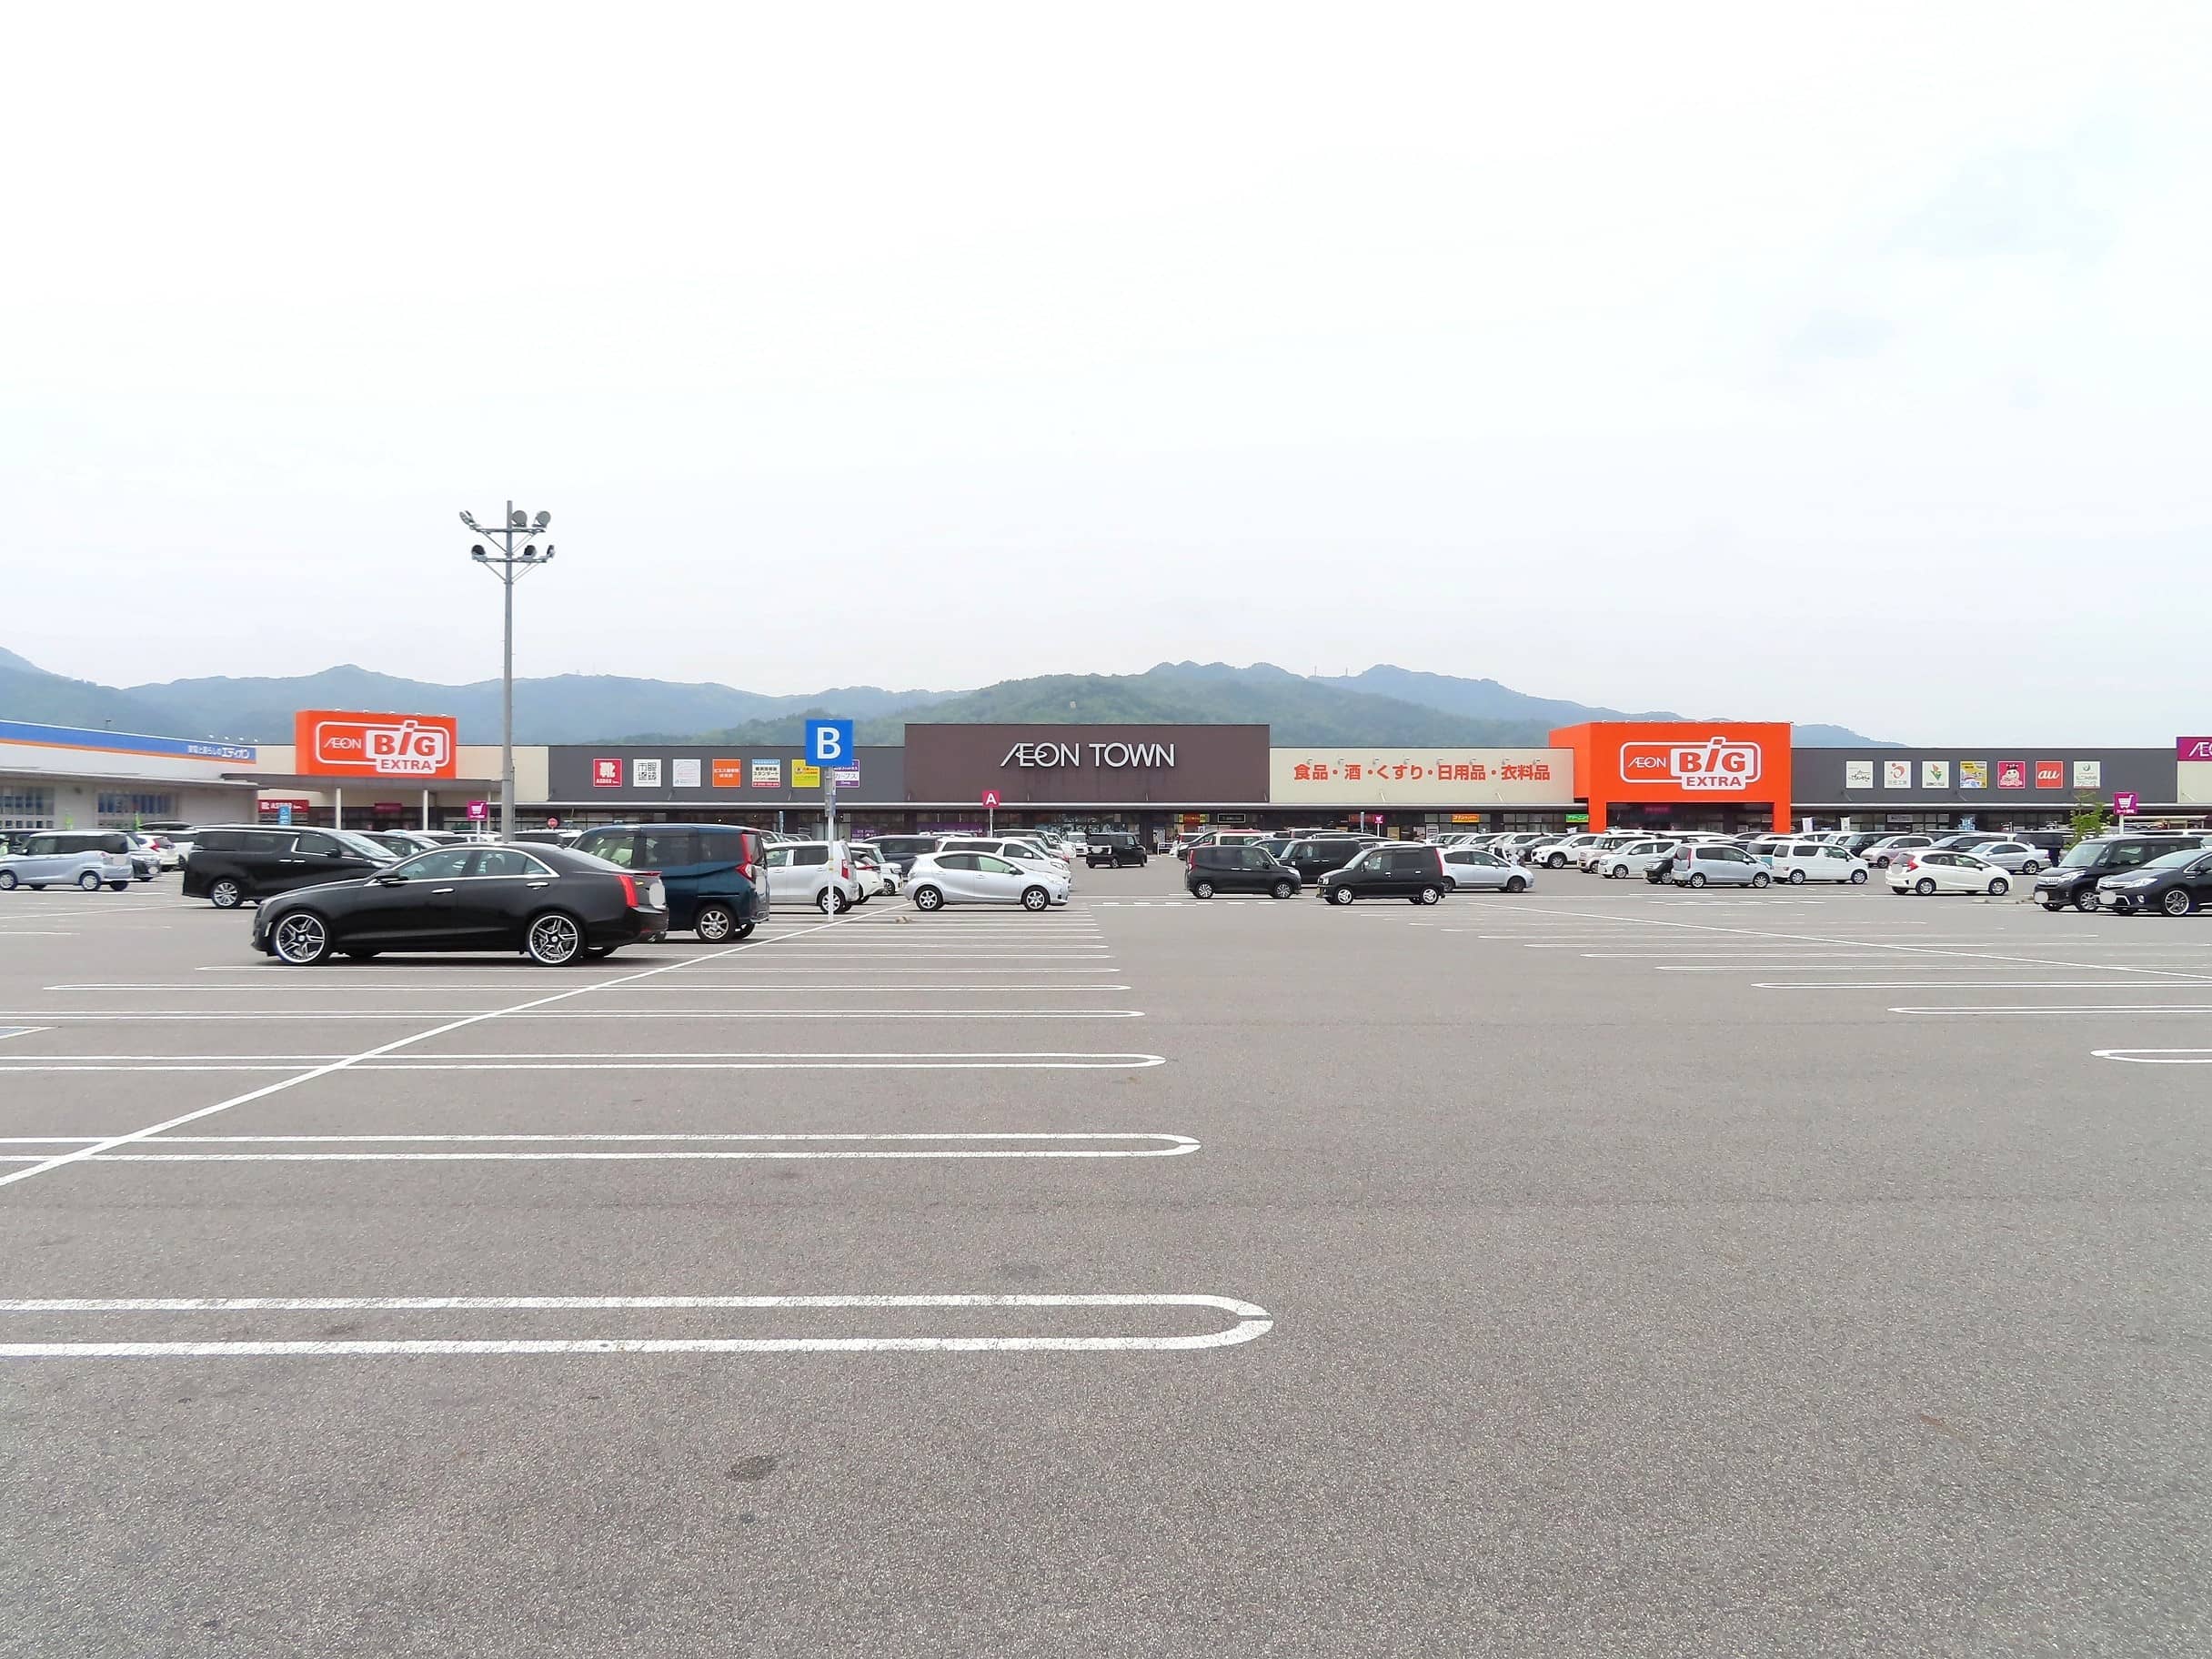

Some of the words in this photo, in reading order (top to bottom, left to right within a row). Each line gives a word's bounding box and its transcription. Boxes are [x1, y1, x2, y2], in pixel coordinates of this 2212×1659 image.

[817, 727, 841, 759] B
[1089, 742, 1175, 768] TOWN
[381, 759, 432, 770] EXTRA
[2037, 769, 2060, 779] au
[1686, 777, 1742, 786] EXTRA
[985, 792, 998, 805] A
